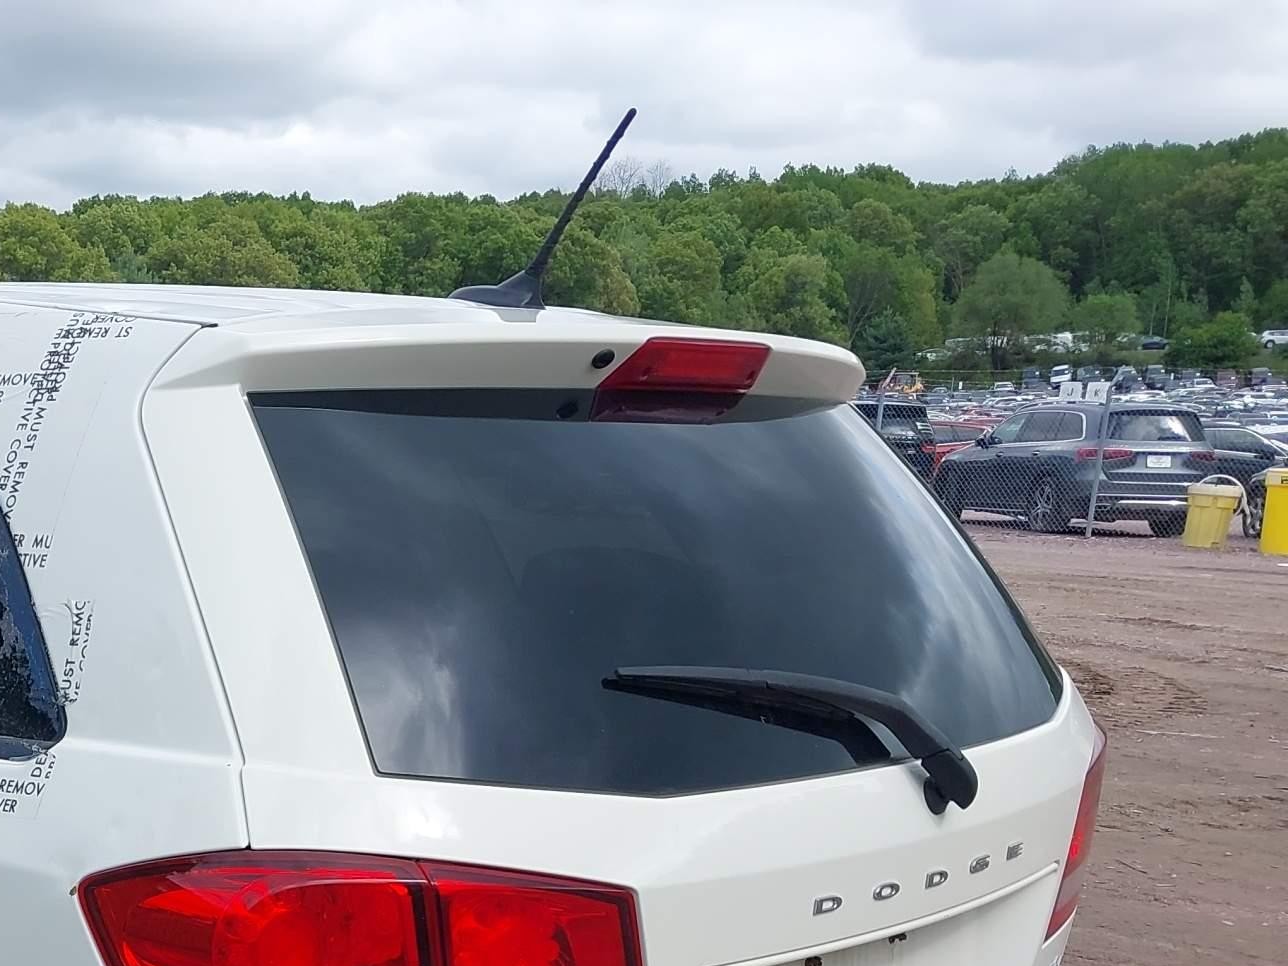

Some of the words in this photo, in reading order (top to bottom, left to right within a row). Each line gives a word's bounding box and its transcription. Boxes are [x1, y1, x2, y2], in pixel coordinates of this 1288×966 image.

[24, 406, 47, 451] MUST
[2, 461, 29, 522] REMOV
[813, 841, 1024, 916] DODGE
